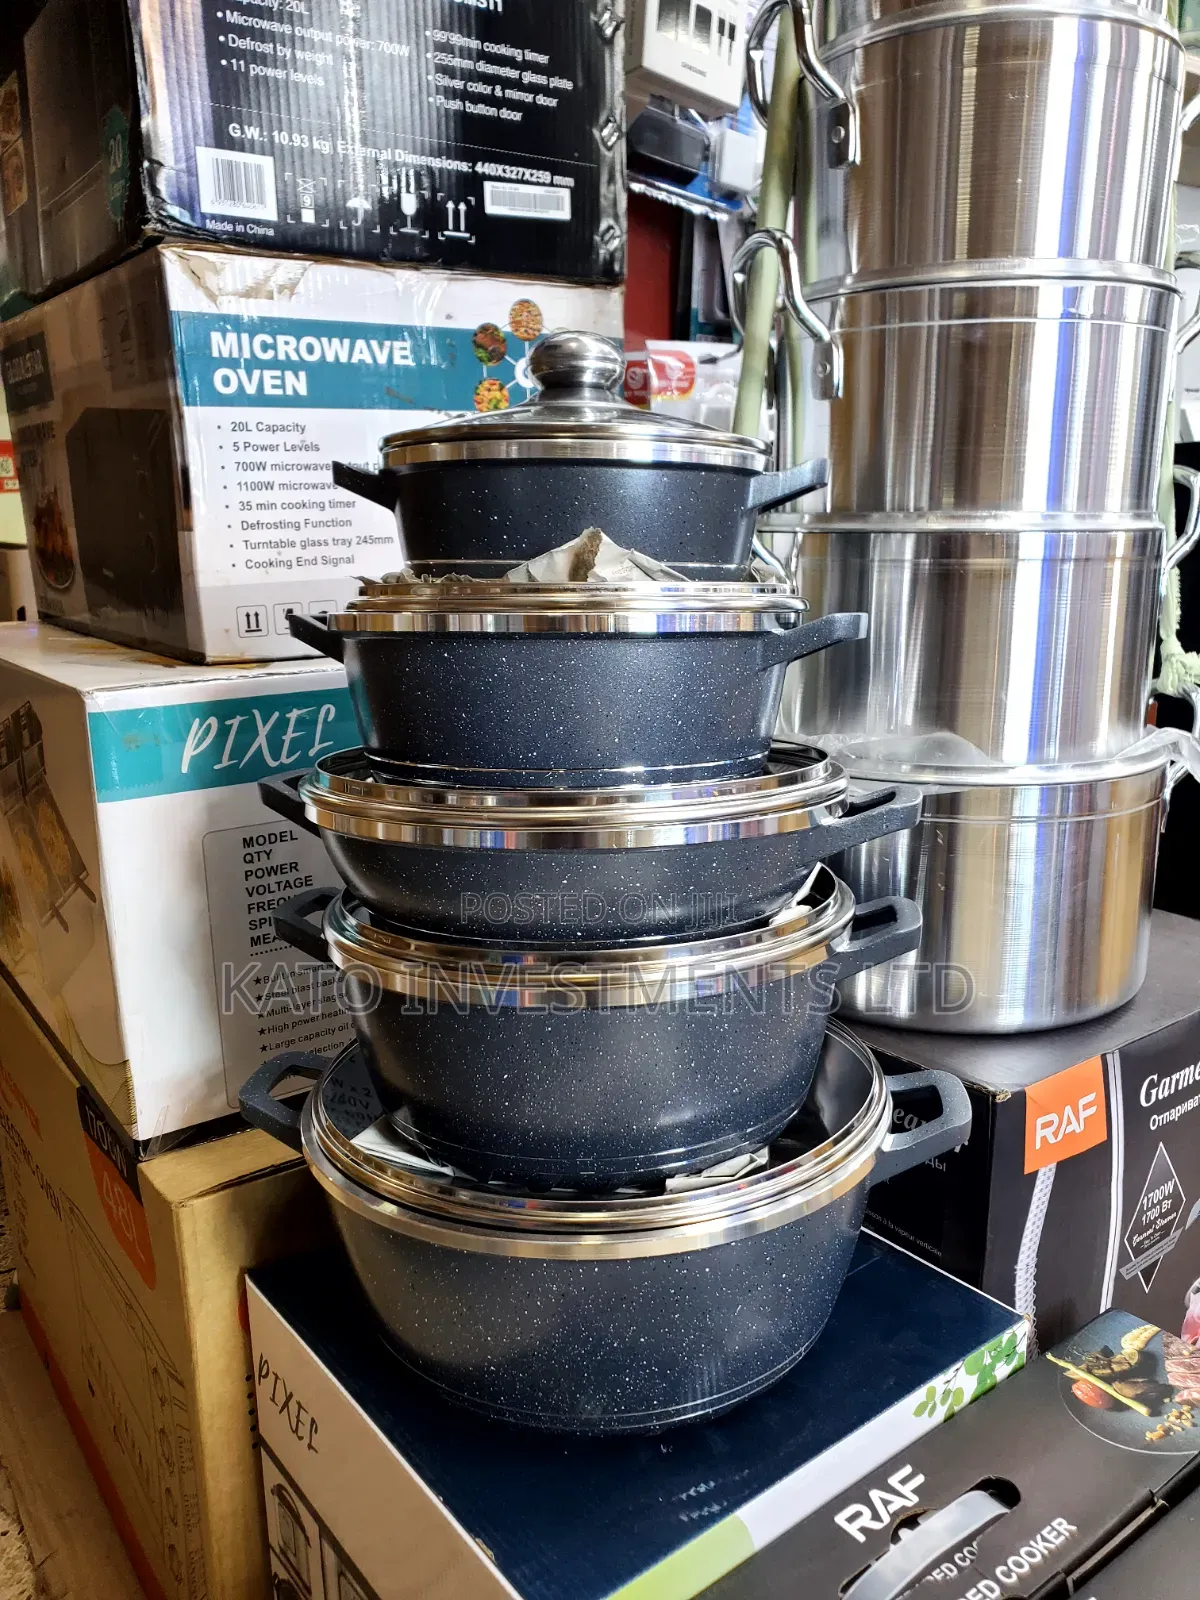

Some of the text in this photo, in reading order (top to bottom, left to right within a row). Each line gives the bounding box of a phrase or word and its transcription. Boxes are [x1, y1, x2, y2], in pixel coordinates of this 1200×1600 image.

[225, 10, 292, 34] Microwave
[295, 27, 333, 42] output
[377, 40, 410, 57] 700W
[228, 34, 334, 67] Defrost by weight
[483, 42, 523, 61] cooking
[524, 49, 550, 64] timer
[230, 59, 325, 87] 11 power levels
[433, 51, 574, 91] 255mm diameter glass plate
[434, 73, 559, 108] Silver color & mirror door
[436, 95, 523, 121] Push button door
[228, 123, 268, 142] G.W.:
[272, 130, 309, 148] 10.93
[395, 148, 473, 173] Dimensions:
[474, 161, 552, 184] 440X327X259
[552, 174, 575, 187] mm
[205, 218, 275, 237] Made in China
[209, 331, 412, 366] MICROWAVE
[213, 368, 309, 396] OVEN
[230, 421, 307, 435] 20L Capacity
[232, 441, 320, 452] 5 Power Levels
[234, 461, 267, 472] 700W
[270, 461, 331, 472] microwave
[236, 480, 275, 491] 1100W
[238, 498, 356, 512] 35 min cooking timer
[241, 518, 352, 532] Defrosting Function
[242, 535, 394, 550] Turntable glass tray 245mm
[245, 554, 355, 570] Cooking End Signal
[181, 703, 336, 774] PIXEL
[242, 830, 299, 849] MODEL
[243, 848, 273, 865] QTY
[244, 861, 299, 881] POWER
[245, 875, 314, 898] VOLTAGE
[265, 989, 290, 1001] Steel
[291, 983, 315, 995] blast
[267, 1022, 290, 1035] High
[291, 1015, 320, 1029] power
[269, 1037, 296, 1051] Large
[298, 1026, 336, 1043] capacity
[338, 1021, 350, 1032] oil
[1139, 1060, 1200, 1107] Garme
[1035, 1091, 1098, 1150] RAF
[1142, 1178, 1176, 1211] 1700W
[1141, 1205, 1160, 1226] 1700
[258, 1352, 319, 1454] PIXEL
[833, 1464, 925, 1543] RAF
[995, 1517, 1078, 1585] COOKER
